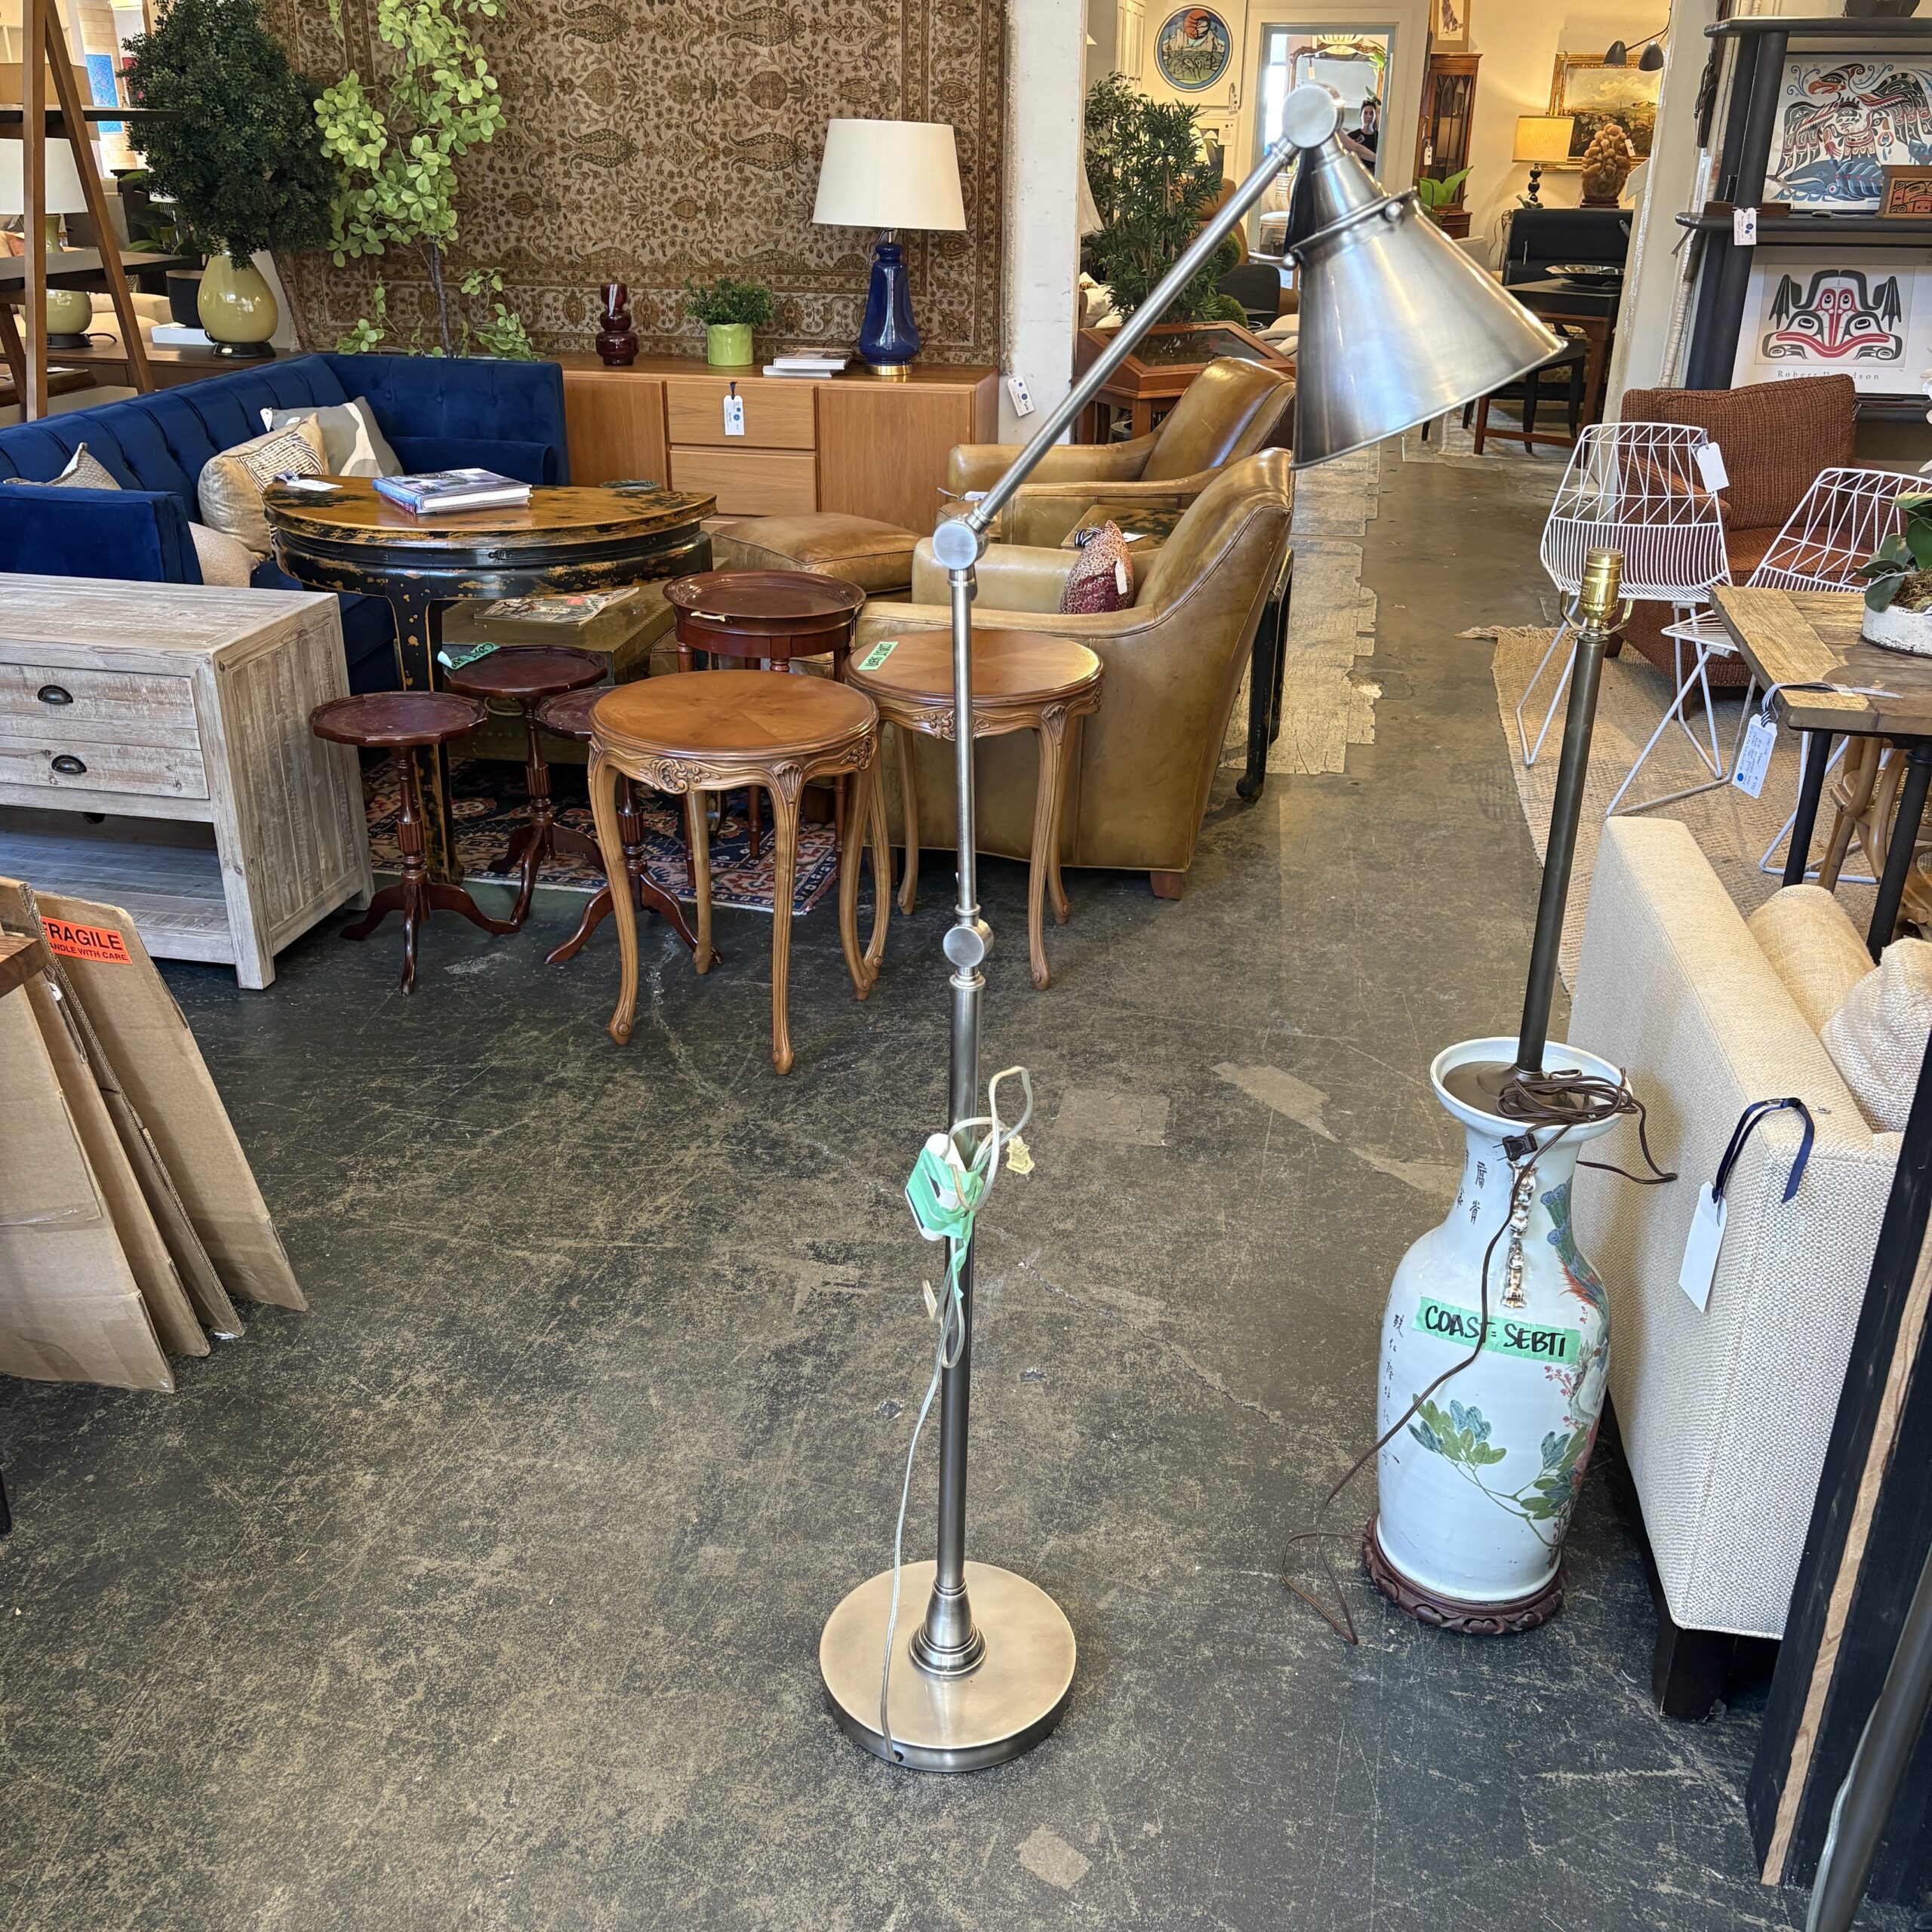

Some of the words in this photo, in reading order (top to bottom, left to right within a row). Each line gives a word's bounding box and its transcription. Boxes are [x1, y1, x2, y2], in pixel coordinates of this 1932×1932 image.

[1823, 371, 1879, 380] Ddson
[78, 948, 100, 958] WITH
[102, 952, 128, 961] CARE
[1503, 1322, 1567, 1358] SEBTI
